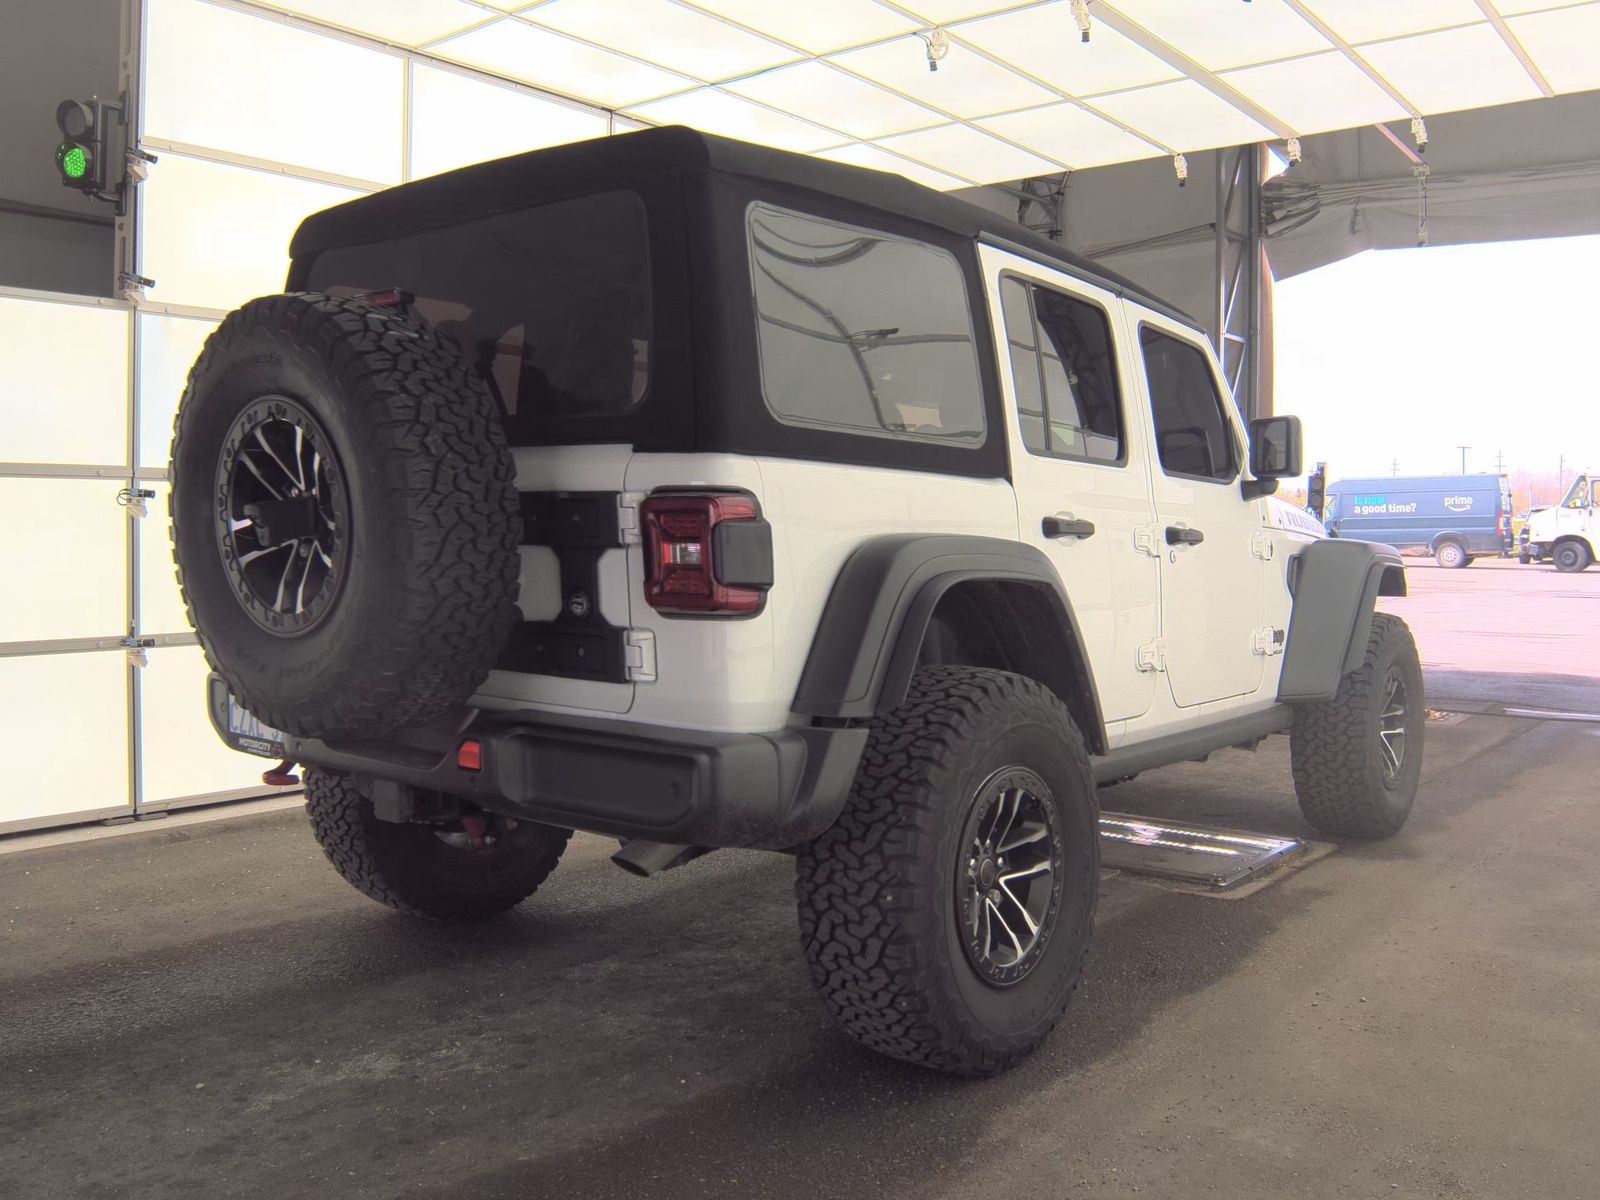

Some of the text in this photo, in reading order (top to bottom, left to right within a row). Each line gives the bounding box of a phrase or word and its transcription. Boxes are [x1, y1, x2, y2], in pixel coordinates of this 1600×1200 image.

[1365, 496, 1385, 505] now
[1444, 496, 1473, 507] prime
[1354, 502, 1416, 515] a good time?
